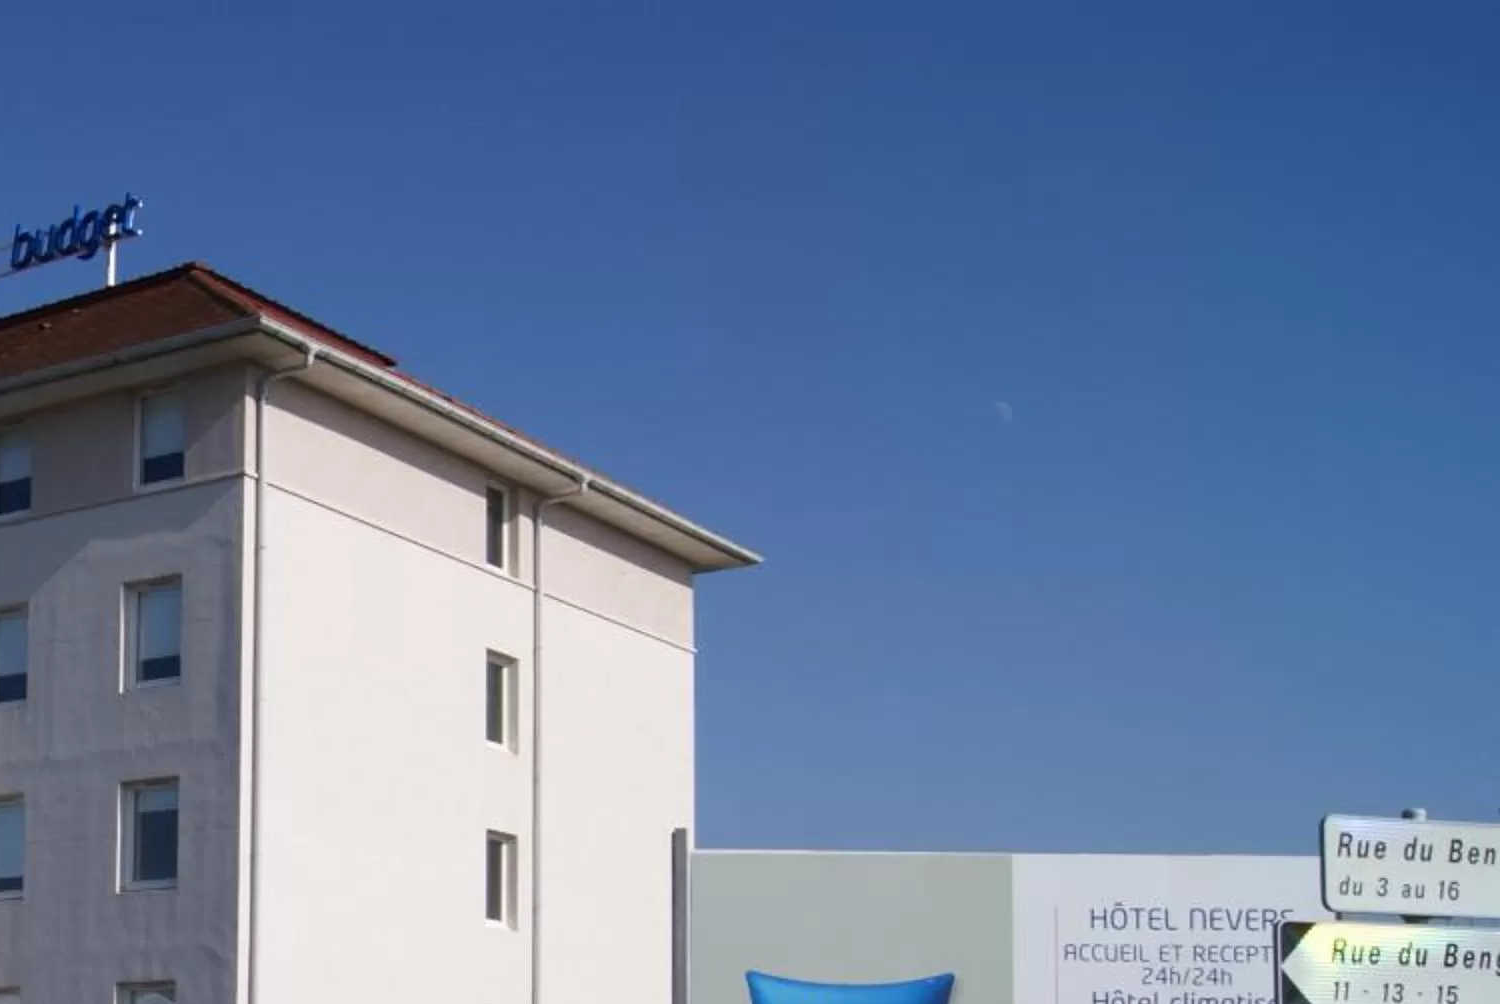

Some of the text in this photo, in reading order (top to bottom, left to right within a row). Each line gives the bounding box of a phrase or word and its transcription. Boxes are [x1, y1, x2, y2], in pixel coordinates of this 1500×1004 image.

[11, 192, 143, 270] budget
[1337, 831, 1388, 859] Rue
[1403, 837, 1433, 862] du
[1338, 876, 1461, 901] du 3 au 16
[1089, 903, 1179, 932] HÔTEL
[1063, 943, 1150, 963] ACCUEIL
[1159, 944, 1184, 963] ET
[1332, 937, 1381, 965] Rue
[1398, 941, 1429, 967] du
[1140, 966, 1233, 986] 24h/24h
[1333, 981, 1350, 1001] 11
[1383, 983, 1405, 1003] 13
[1438, 985, 1460, 1004] 15
